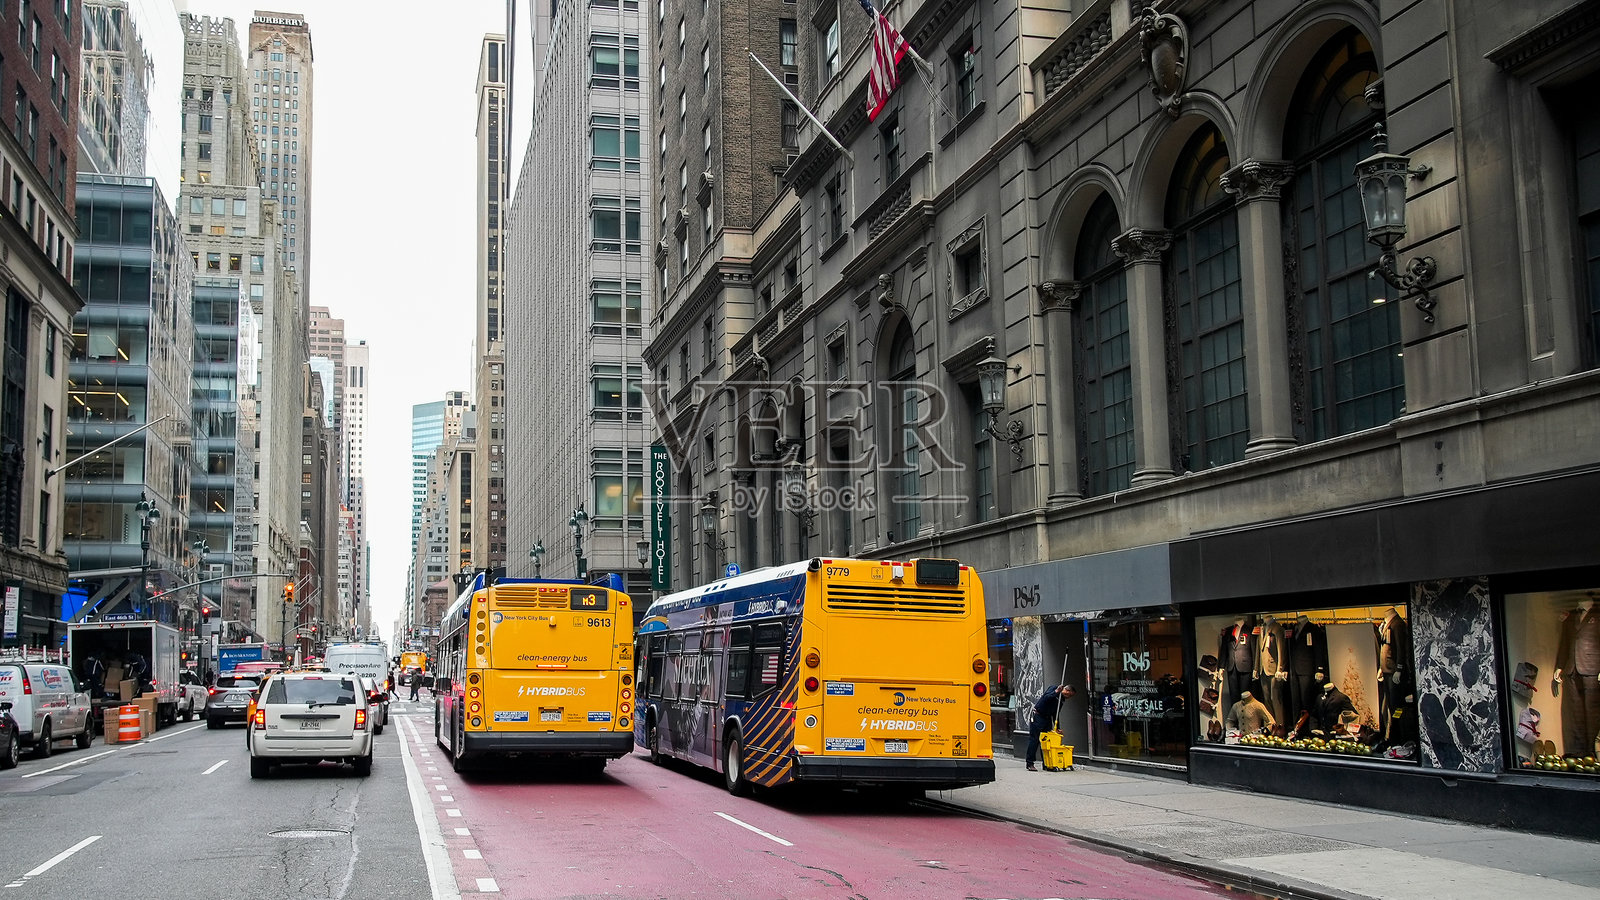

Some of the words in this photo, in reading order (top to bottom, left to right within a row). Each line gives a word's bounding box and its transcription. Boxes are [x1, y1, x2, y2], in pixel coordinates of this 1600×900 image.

[253, 16, 304, 26] BURBERRY
[653, 452, 667, 460] THE
[655, 461, 665, 538] ROOSEVELT
[655, 540, 666, 583] HOTEL
[826, 566, 850, 577] 9779
[582, 594, 596, 606] M3
[1013, 584, 1041, 609] PS45
[587, 617, 611, 628] 9613
[517, 653, 572, 662] clean-energy
[572, 654, 588, 662] bus
[1122, 651, 1151, 672] PS45
[526, 687, 586, 697] HYBRIDBUS
[1115, 698, 1142, 710] SAMPLE
[1144, 700, 1163, 711] SALE
[857, 706, 920, 717] clean-energy
[921, 707, 939, 716] bus
[869, 719, 938, 732] HYBRIDBUS
